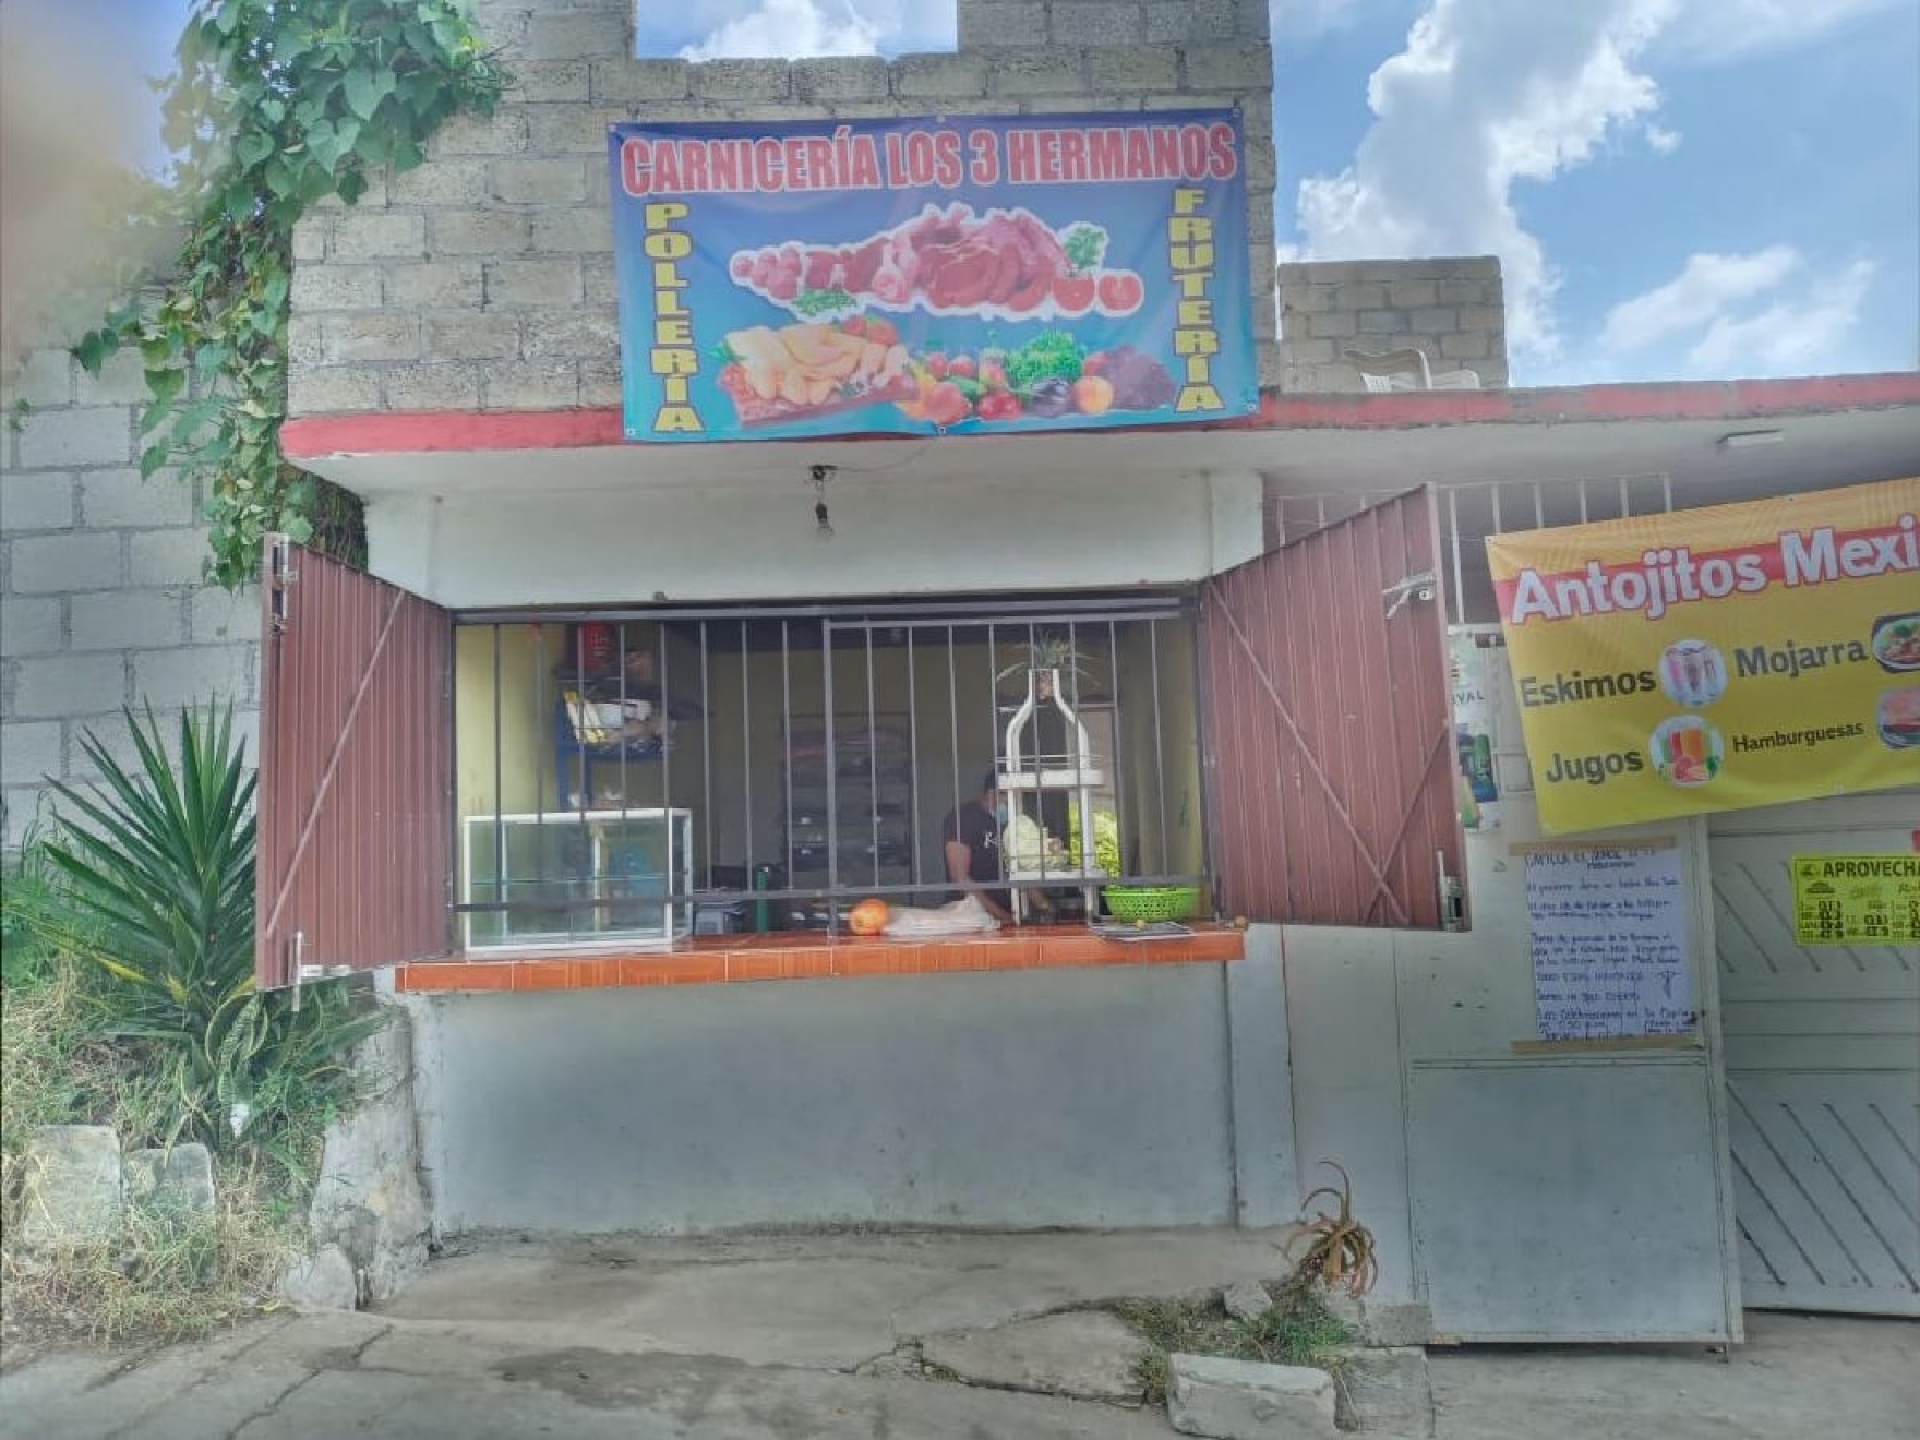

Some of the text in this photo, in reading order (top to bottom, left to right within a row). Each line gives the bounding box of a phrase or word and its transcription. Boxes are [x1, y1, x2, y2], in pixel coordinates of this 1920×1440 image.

[621, 121, 1237, 196] CARNICERÍA LOS 3 HERMANOS
[643, 202, 705, 432] POLLERIA
[1167, 186, 1226, 412] FRUTERIA
[1510, 546, 1768, 625] Antojitos
[1735, 639, 1869, 678] Mojarra
[1520, 670, 1657, 708] Eskimos
[1732, 721, 1865, 753] Hamburguesas
[1546, 750, 1644, 785] Jugos
[1823, 860, 1920, 878] APROVECH
